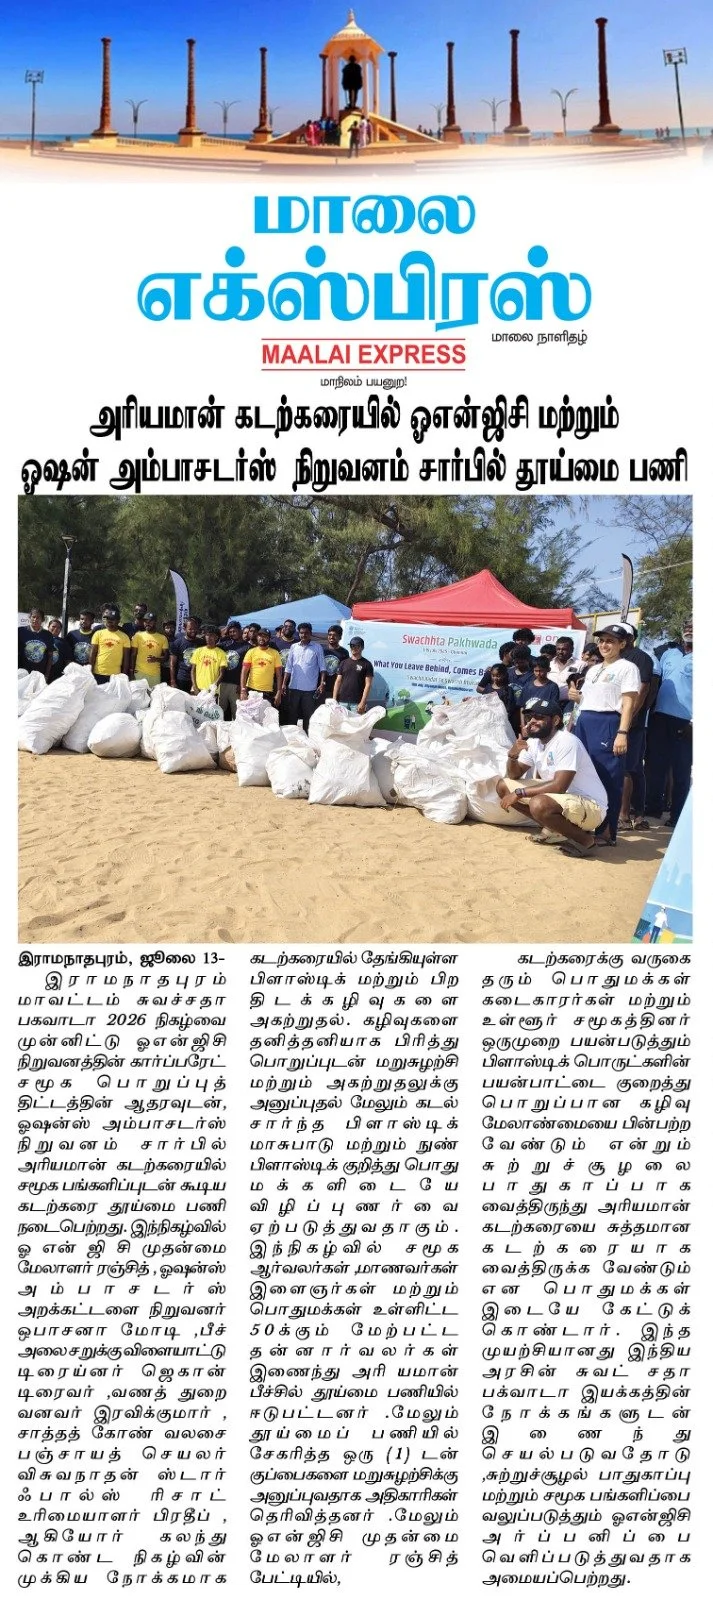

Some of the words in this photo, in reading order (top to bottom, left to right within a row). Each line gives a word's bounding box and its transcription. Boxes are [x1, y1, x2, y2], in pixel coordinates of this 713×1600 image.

[254, 194, 476, 235] மாலை
[137, 245, 592, 331] எக்ஸ்பிரஸ்
[491, 332, 534, 343] மாலை
[537, 330, 587, 345] நாளிதழ்
[263, 344, 350, 364] MAALAI
[359, 344, 466, 364] EXPRESS
[321, 376, 362, 389] மாநிலம்
[367, 377, 407, 390] பயனுற!
[90, 394, 225, 441] அரியமான்
[235, 394, 400, 438] கடற்கரையில்
[411, 395, 528, 444] ஓஎன்ஜிசி
[539, 395, 619, 440] மற்றும்
[22, 447, 99, 495] ஓஷன்
[109, 447, 276, 493] அம்பாசடர்ஸ்
[292, 447, 409, 492] நிறுவனம்
[419, 446, 506, 481] சார்பில்
[516, 447, 619, 491] தூய்மை
[630, 447, 687, 481] பணி
[402, 634, 446, 647] Swachhta
[447, 636, 498, 649] Pakhwada
[374, 660, 390, 668] What
[404, 663, 424, 671] Leave
[453, 666, 477, 676] Comes
[18, 950, 132, 969] இராமநாதபுரம்,
[140, 950, 196, 968] ஜூலை
[250, 950, 357, 968] கடற்கரையில்
[361, 950, 458, 968] தேங்கியுள்ள
[517, 951, 623, 969] கடற்கரைக்கு
[631, 955, 691, 969] வருகை
[250, 971, 346, 989] பிளாஸ்டிக்
[358, 972, 419, 989] மற்றும்
[431, 971, 459, 989] பிற
[482, 972, 532, 989] தரும்
[552, 971, 691, 989] பொதுமக்கள்
[18, 993, 120, 1005] மாவட்டம்
[137, 993, 226, 1010] சுவச்சதா
[482, 993, 615, 1008] கடைகாரர்கள்
[629, 993, 691, 1010] மற்றும்
[18, 1017, 96, 1026] பகவாடா
[106, 1013, 147, 1026] 2026
[155, 1012, 226, 1031] நிகழ்வை
[250, 1013, 350, 1030] அகற்றுதல்.
[363, 1012, 458, 1031] கழிவுகளை
[482, 1013, 557, 1031] உள்ளூர்
[573, 1012, 690, 1030] சமூகத்தினர்
[18, 1033, 120, 1051] முன்னிட்டு
[137, 1033, 227, 1052] ஓஎன்ஜிசி
[250, 1033, 381, 1051] தனித்தனியாக
[395, 1033, 459, 1051] பிரித்து
[482, 1037, 560, 1052] ஒருமுறை
[570, 1034, 691, 1051] பயன்படுத்தும்
[17, 1053, 125, 1072] நிறுவனத்தின்
[130, 1053, 226, 1070] கார்ப்பரேட்
[250, 1053, 366, 1072] பொறுப்புடன்
[376, 1053, 459, 1073] மறுசுழற்சி
[482, 1053, 570, 1072] பிளாஸ்டிக்
[574, 1053, 691, 1072] பொருட்களின்
[250, 1075, 312, 1093] மற்றும்
[326, 1075, 458, 1093] அகற்றுதலுக்கு
[482, 1075, 605, 1088] பயன்பாட்டை
[617, 1075, 691, 1093] குறைத்து
[17, 1095, 113, 1112] திட்டத்தின்
[124, 1096, 226, 1114] ஆதரவுடன்,
[250, 1096, 342, 1114] அனுப்புதல்
[350, 1094, 407, 1113] மேலும்
[416, 1096, 458, 1108] கடல்
[482, 1095, 621, 1113] பொறுப்பான
[640, 1095, 691, 1114] கழிவு
[18, 1116, 90, 1135] ஓஷன்ஸ்
[102, 1116, 226, 1132] அம்பாசடர்ஸ்
[482, 1115, 617, 1129] மேலாண்மையை
[622, 1115, 691, 1133] பின்பற்ற
[250, 1137, 334, 1154] மாசுபாடு
[347, 1137, 406, 1154] மற்றும்
[416, 1137, 459, 1154] நுண்
[18, 1157, 107, 1174] அரியமான்
[116, 1157, 226, 1175] கடற்கரையில்
[250, 1157, 338, 1175] பிளாஸ்டிக்
[343, 1157, 400, 1175] குறித்து
[404, 1157, 459, 1175] பொது
[18, 1182, 59, 1196] சமூக
[62, 1177, 176, 1195] பங்களிப்புடன்
[180, 1182, 226, 1195] கூடிய
[18, 1199, 98, 1216] கடற்கரை
[107, 1199, 175, 1216] தூய்மை
[186, 1198, 227, 1212] பணி
[482, 1198, 587, 1216] வைத்திருந்து
[598, 1198, 690, 1215] அரியமான்
[17, 1219, 127, 1237] நடைபெற்றது.
[130, 1219, 226, 1238] இந்நிகழ்வில்
[482, 1220, 596, 1237] கடற்கரையை
[607, 1220, 690, 1237] சுத்தமான
[250, 1261, 350, 1279] ஆர்வலர்கள்
[482, 1260, 590, 1278] வைத்திருக்க
[603, 1260, 691, 1277] வேண்டும்
[249, 1281, 376, 1300] இளைஞர்கள்
[393, 1281, 458, 1299] மற்றும்
[18, 1302, 139, 1319] அறக்கட்டளை
[149, 1301, 226, 1320] நிறுவனர்
[250, 1301, 362, 1320] பொதுமக்கள்
[373, 1301, 458, 1315] உள்ளிட்ட
[121, 1322, 180, 1340] மோடி
[482, 1342, 615, 1361] முயற்சியானது
[628, 1342, 691, 1362] இந்திய
[142, 1363, 225, 1383] ஜெகான்
[18, 1385, 94, 1402] டிரைவர்
[250, 1384, 303, 1398] பீச்சில்
[311, 1385, 378, 1402] தூய்மை
[387, 1384, 458, 1398] பணியில்
[482, 1385, 568, 1398] பக்வாடா
[581, 1384, 690, 1404] இயக்கத்தின்
[164, 1429, 227, 1439] வலசை
[250, 1446, 330, 1464] சேகரித்த
[343, 1450, 373, 1465] ஒரு
[386, 1446, 410, 1464] (1)
[422, 1447, 459, 1459] டன்
[18, 1466, 139, 1484] விசுவநாதன்
[158, 1467, 226, 1480] ஸ்டார்
[250, 1468, 349, 1485] குப்பைகளை
[353, 1466, 458, 1486] மறுசுழற்சிக்கு
[599, 1468, 691, 1485] பாதுகாப்பு
[250, 1488, 362, 1507] அனுப்புவதாக
[365, 1487, 458, 1505] அதிகாரிகள்
[482, 1488, 538, 1506] மற்றும்
[543, 1492, 585, 1506] சமூக
[590, 1487, 690, 1501] பங்களிப்பை
[250, 1507, 374, 1526] தெரிவித்தனர்
[482, 1508, 602, 1526] வலுப்படுத்தும்
[612, 1507, 691, 1527] ஓஎன்ஜிசி
[18, 1570, 88, 1588] முக்கிய
[107, 1570, 227, 1588] நோக்கமாக
[250, 1570, 341, 1588] பேட்டியில்,
[482, 1570, 630, 1588] அமையப்பெற்றது.
